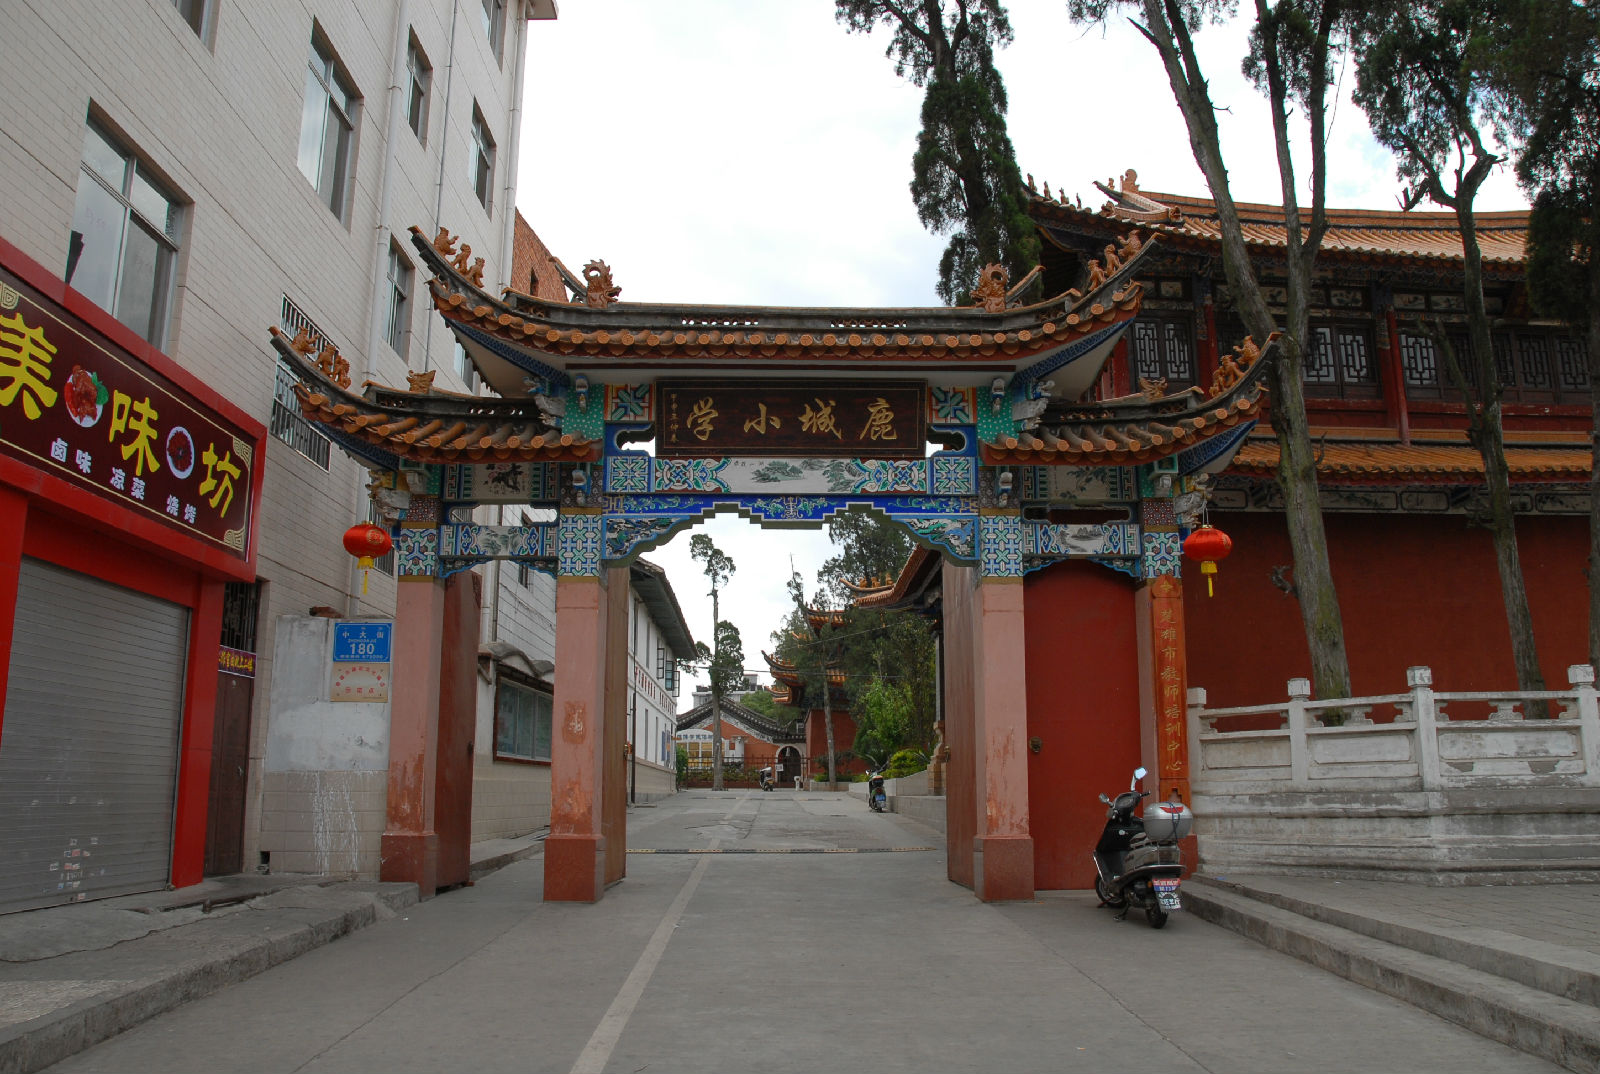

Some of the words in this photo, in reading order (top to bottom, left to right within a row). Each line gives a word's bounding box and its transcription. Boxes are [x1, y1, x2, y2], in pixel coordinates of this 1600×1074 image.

[50, 437, 92, 473] 卤味
[110, 466, 146, 500] 凉菜
[166, 494, 197, 524] 烧烤
[342, 631, 384, 639] 中大街
[350, 643, 375, 655] 180
[1160, 609, 1182, 771] 楚雄市教师培训中心
